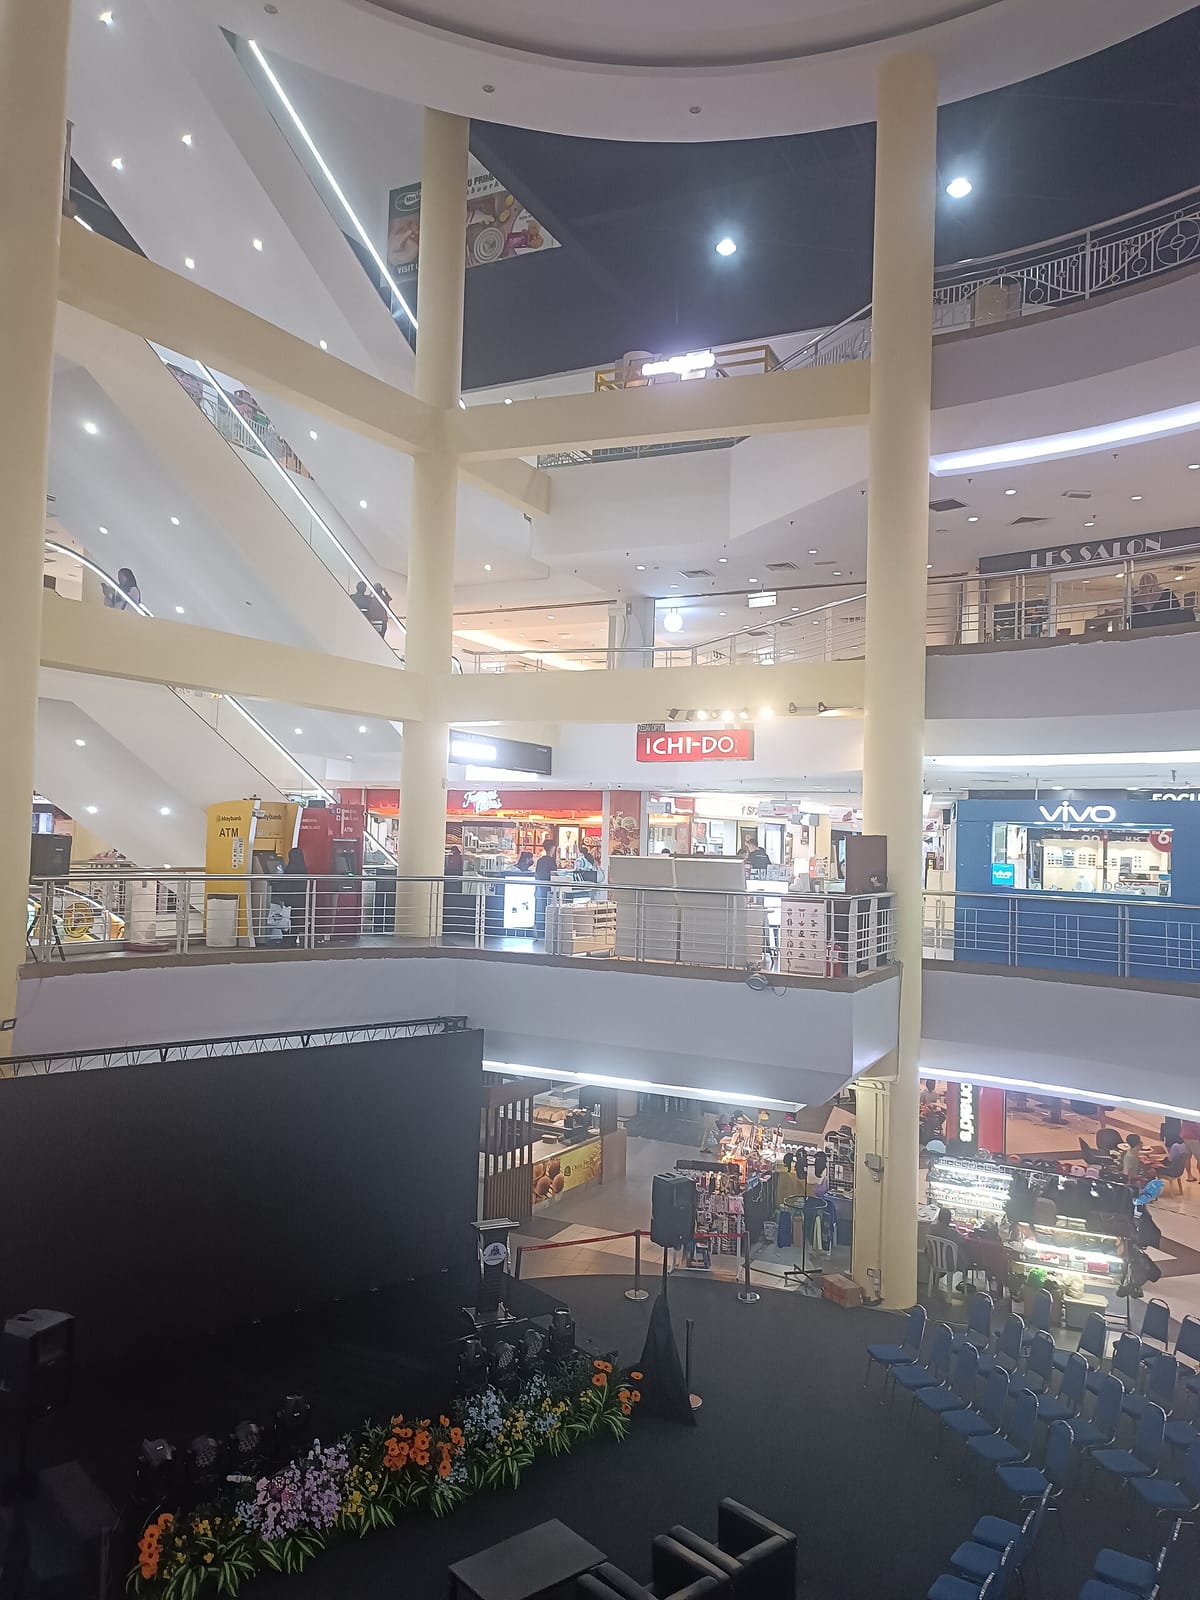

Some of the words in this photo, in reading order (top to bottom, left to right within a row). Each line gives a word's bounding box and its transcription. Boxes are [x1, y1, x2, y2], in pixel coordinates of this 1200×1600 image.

[1079, 536, 1161, 561] SALON
[645, 735, 735, 755] ICHI-DO
[221, 815, 242, 823] Maybank
[218, 827, 239, 838] ATM
